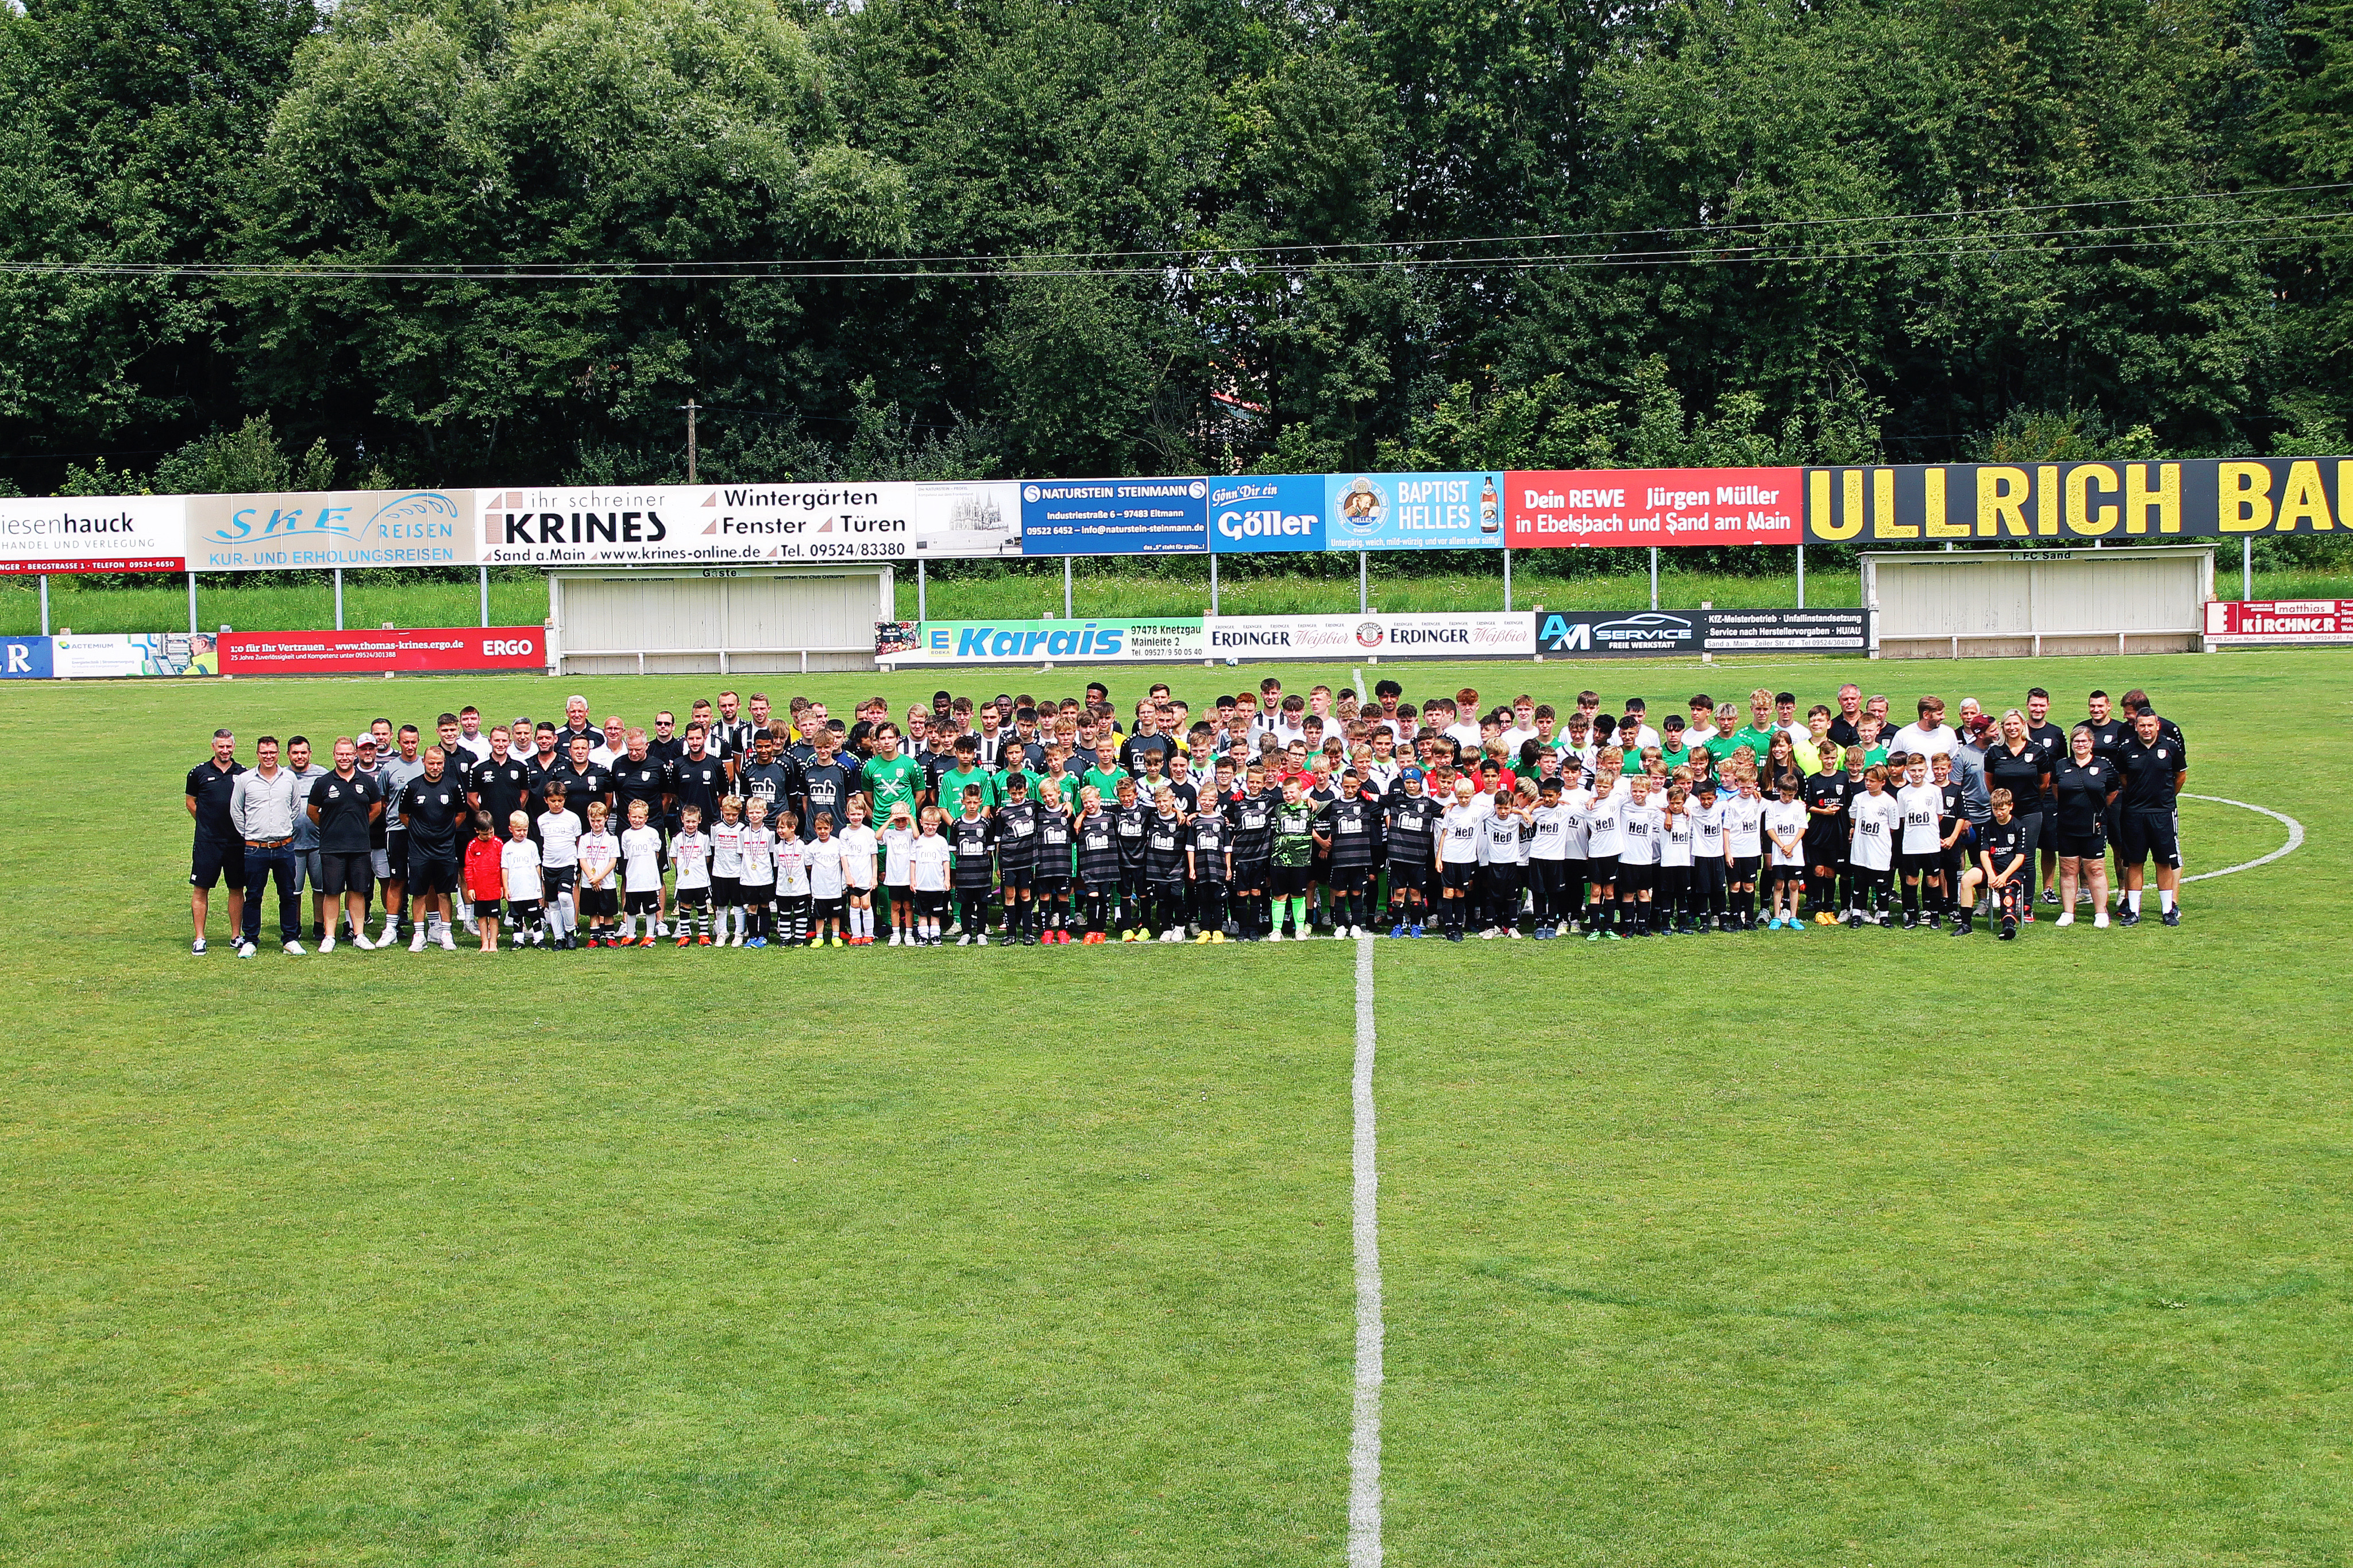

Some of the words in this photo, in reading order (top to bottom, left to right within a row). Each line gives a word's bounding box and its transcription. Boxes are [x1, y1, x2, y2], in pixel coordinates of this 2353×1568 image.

[1042, 486, 1113, 499] NATURSTEIN
[1117, 485, 1187, 498] STEINMANN
[1262, 482, 1278, 495] ein
[1398, 481, 1470, 503] BAPTIST
[531, 491, 558, 507] ihr
[569, 490, 665, 507] schreiner
[724, 489, 878, 511] Wintergärten
[1524, 489, 1565, 509] Dein
[1569, 488, 1626, 508] REWE
[1646, 487, 1710, 511] Jürgen
[1716, 485, 1780, 505] Müller
[1809, 462, 2181, 541] ULLRICH
[2217, 459, 2353, 533] BA
[1047, 511, 1108, 520] Industriestraße
[1109, 510, 1116, 519] 6
[1124, 509, 1148, 519] 97483
[1150, 509, 1184, 517] Eltmann
[1399, 505, 1471, 530] HELLES
[216, 507, 352, 539] SKE
[506, 512, 666, 544] KRINES
[723, 517, 807, 534] Fenster
[840, 515, 905, 532] Türen
[1027, 527, 1052, 535] 09522
[1053, 526, 1074, 535] 6452
[1081, 523, 1205, 535] info@naturstein-steinmann.de
[1217, 511, 1319, 542] Göller
[1515, 515, 1532, 533] in
[1537, 513, 1623, 535] Ebelsbach
[1629, 512, 1661, 532] und
[1665, 512, 1709, 535] Sand
[1714, 516, 1742, 530] am
[1747, 511, 1791, 531] Main
[379, 524, 453, 538] REISEN
[54, 540, 80, 549] UND
[84, 539, 155, 549] VERLEGUNG
[1330, 538, 1364, 549] Untergärig,
[1365, 538, 1385, 546] weich,
[1386, 537, 1423, 547] mild-würzig
[1425, 537, 1437, 545] und
[1449, 537, 1465, 545] allem
[1467, 536, 1480, 545] sehr
[1482, 536, 1500, 546] süffig!
[210, 553, 249, 565] KUR-
[254, 552, 287, 565] UND
[293, 548, 453, 564] ERHOLUNGSREISEN
[494, 549, 530, 561] Sand
[536, 548, 585, 561] a.Main
[600, 544, 761, 561] www.krines-online.de
[781, 545, 804, 557] Tel.
[810, 543, 905, 557] 09524/83380
[2009, 552, 2019, 560] 1.
[2023, 551, 2038, 559] FC
[2042, 551, 2072, 559] Sand
[28, 562, 78, 570] BERGSTRASSE
[129, 561, 175, 569] 09524-6650
[2279, 604, 2325, 613] matthias
[1708, 614, 1777, 623] KfZ-Meisterbetrieb
[1783, 614, 1862, 623] Unfallinstandsetzung
[1131, 625, 1157, 635] 97478
[1160, 624, 1201, 636] Knetzgau
[1539, 615, 1591, 650] AM
[1596, 629, 1692, 640] SERVICE
[1710, 628, 1738, 636] Service
[1739, 627, 1758, 635] nach
[1759, 627, 1830, 636] Herstellervorgaben
[1836, 626, 1861, 635] HU/AU
[931, 631, 949, 649] E
[957, 623, 1124, 656] Karais
[1131, 638, 1171, 646] Mainleite
[1175, 637, 1180, 646] 2
[1212, 631, 1291, 647] ERDINGER
[1294, 629, 1350, 648] Weißbier
[1391, 628, 1470, 645] ERDINGER
[1472, 628, 1529, 646] Weißbier
[1707, 639, 1724, 647] Sand
[246, 643, 260, 652] für
[262, 643, 276, 652] Ihr
[278, 643, 325, 652] Vertrauen
[335, 640, 464, 651] www.thomas-krines.ergo.de
[483, 639, 533, 655] ERGO
[1631, 641, 1676, 649] WERKSTATT
[255, 653, 295, 661] Zuverlässigkeit
[1145, 648, 1171, 656] 09527/9
[1285, 817, 1307, 830] Heß
[1342, 818, 1363, 831] Heß
[1402, 814, 1423, 828] Heß
[1908, 812, 1930, 824] Heß
[1540, 822, 1559, 833] Heß
[1629, 821, 1648, 835] Heß
[1777, 824, 1795, 834] Heß
[1861, 820, 1880, 834] Heß
[1048, 829, 1067, 841] Heß
[1089, 835, 1109, 847] Heß
[1494, 832, 1512, 843] Heß
[632, 844, 648, 852] ring
[963, 841, 983, 852] Heß
[514, 855, 529, 863] ring
[921, 851, 936, 859] ring
